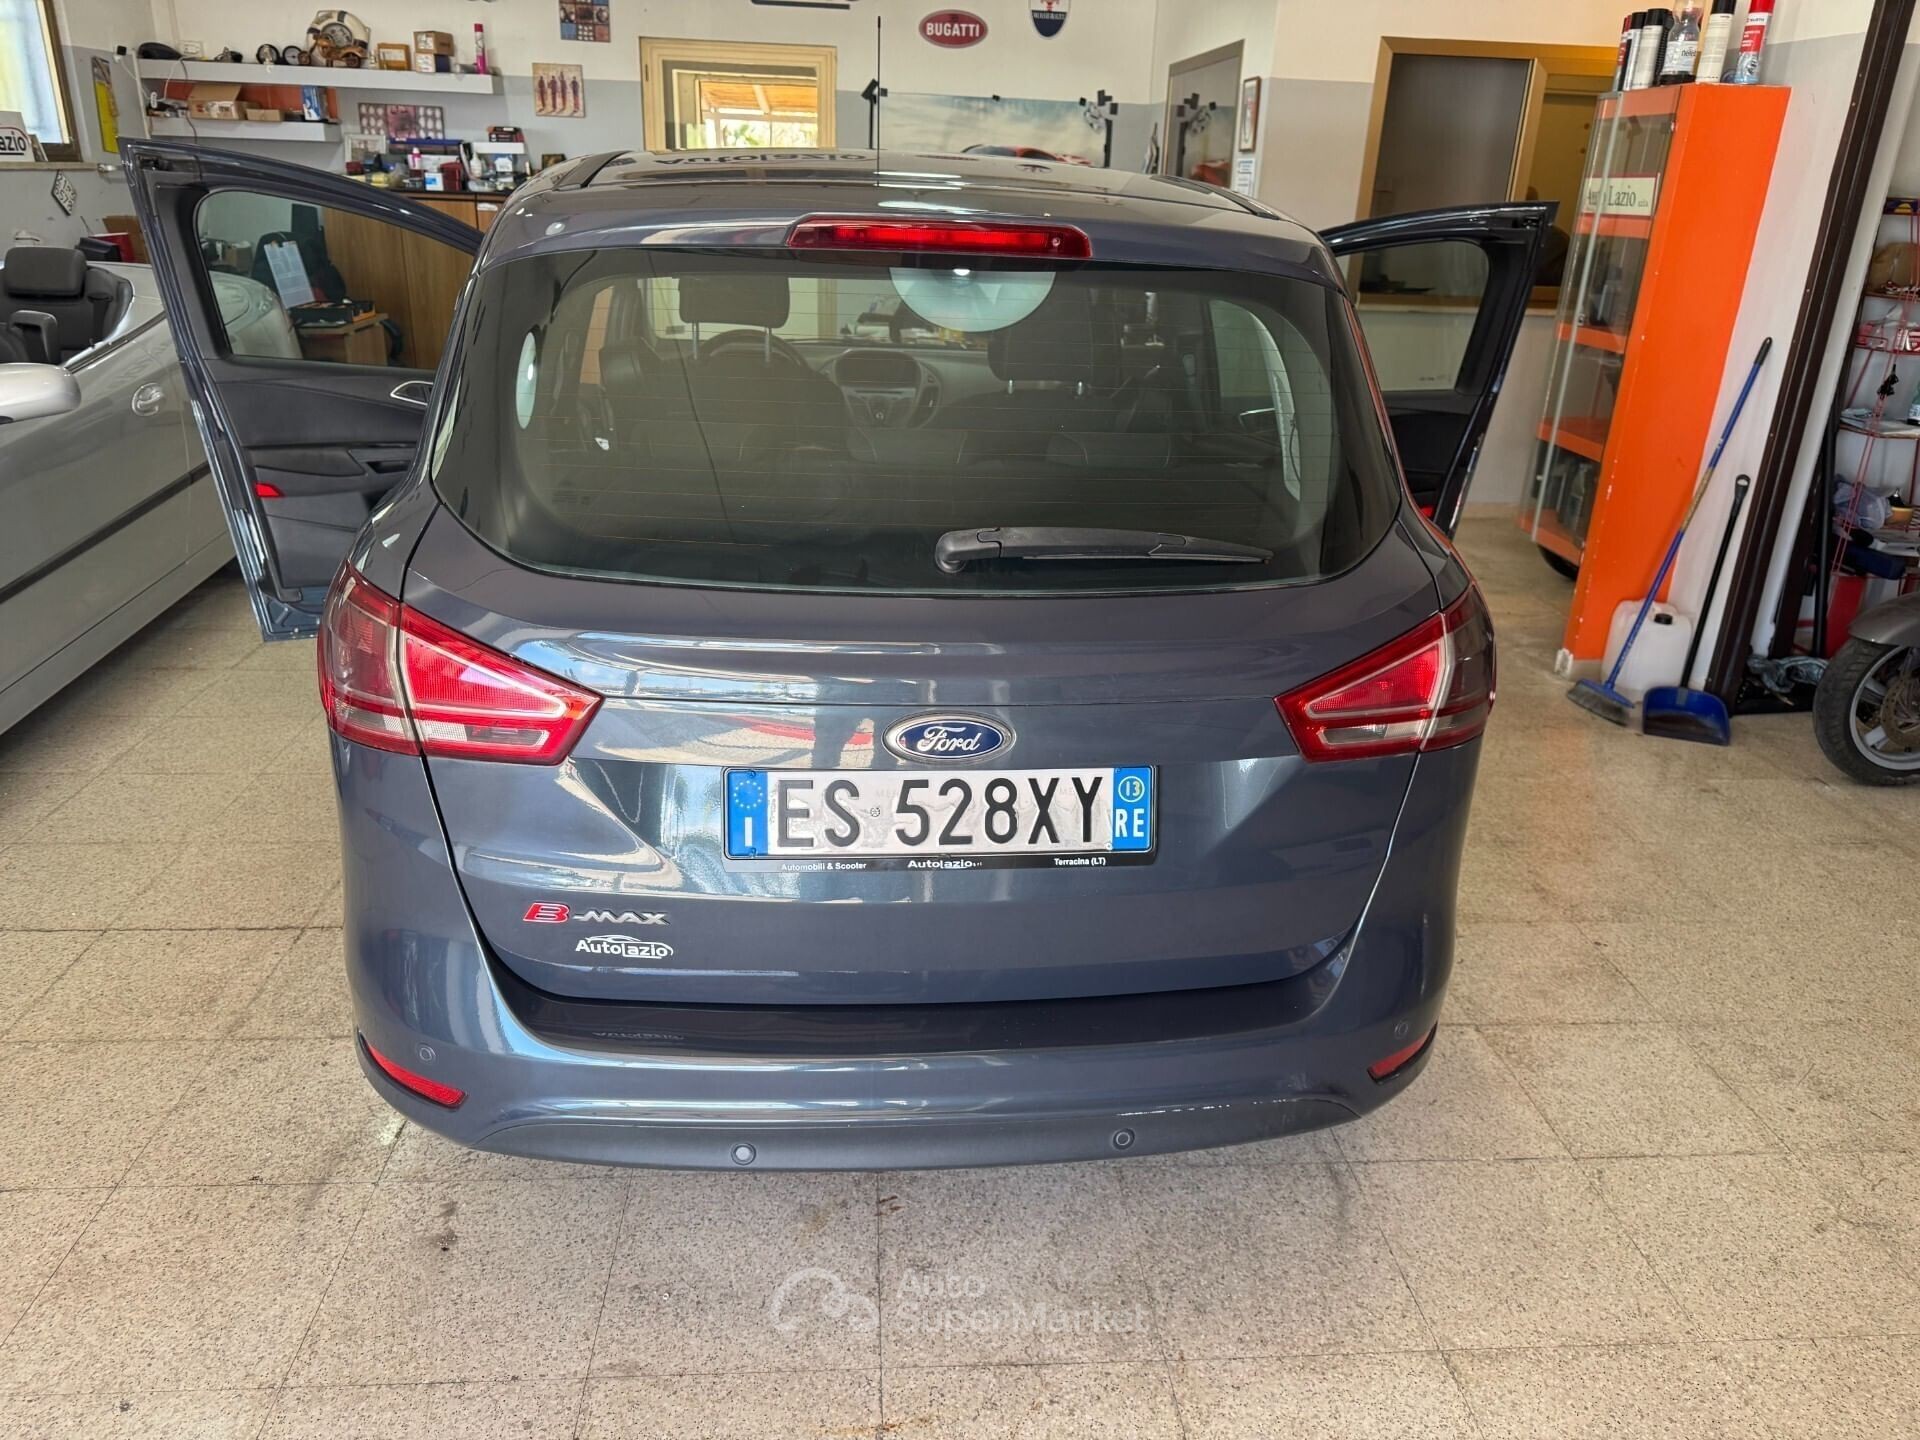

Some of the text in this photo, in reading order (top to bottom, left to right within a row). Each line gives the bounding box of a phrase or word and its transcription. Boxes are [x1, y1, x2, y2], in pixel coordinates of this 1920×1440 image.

[926, 22, 980, 37] BUGATTI
[1608, 185, 1636, 207] Lazio
[917, 726, 982, 751] Ford
[1125, 781, 1141, 797] 13
[777, 779, 860, 847] ES
[896, 777, 1103, 846] 528XY
[1115, 808, 1145, 838] RE
[781, 862, 867, 872] Automobili & Scooter
[908, 859, 973, 869] Autolazio
[1054, 857, 1106, 867] Terracina (LT)
[523, 902, 670, 925] B-MAX
